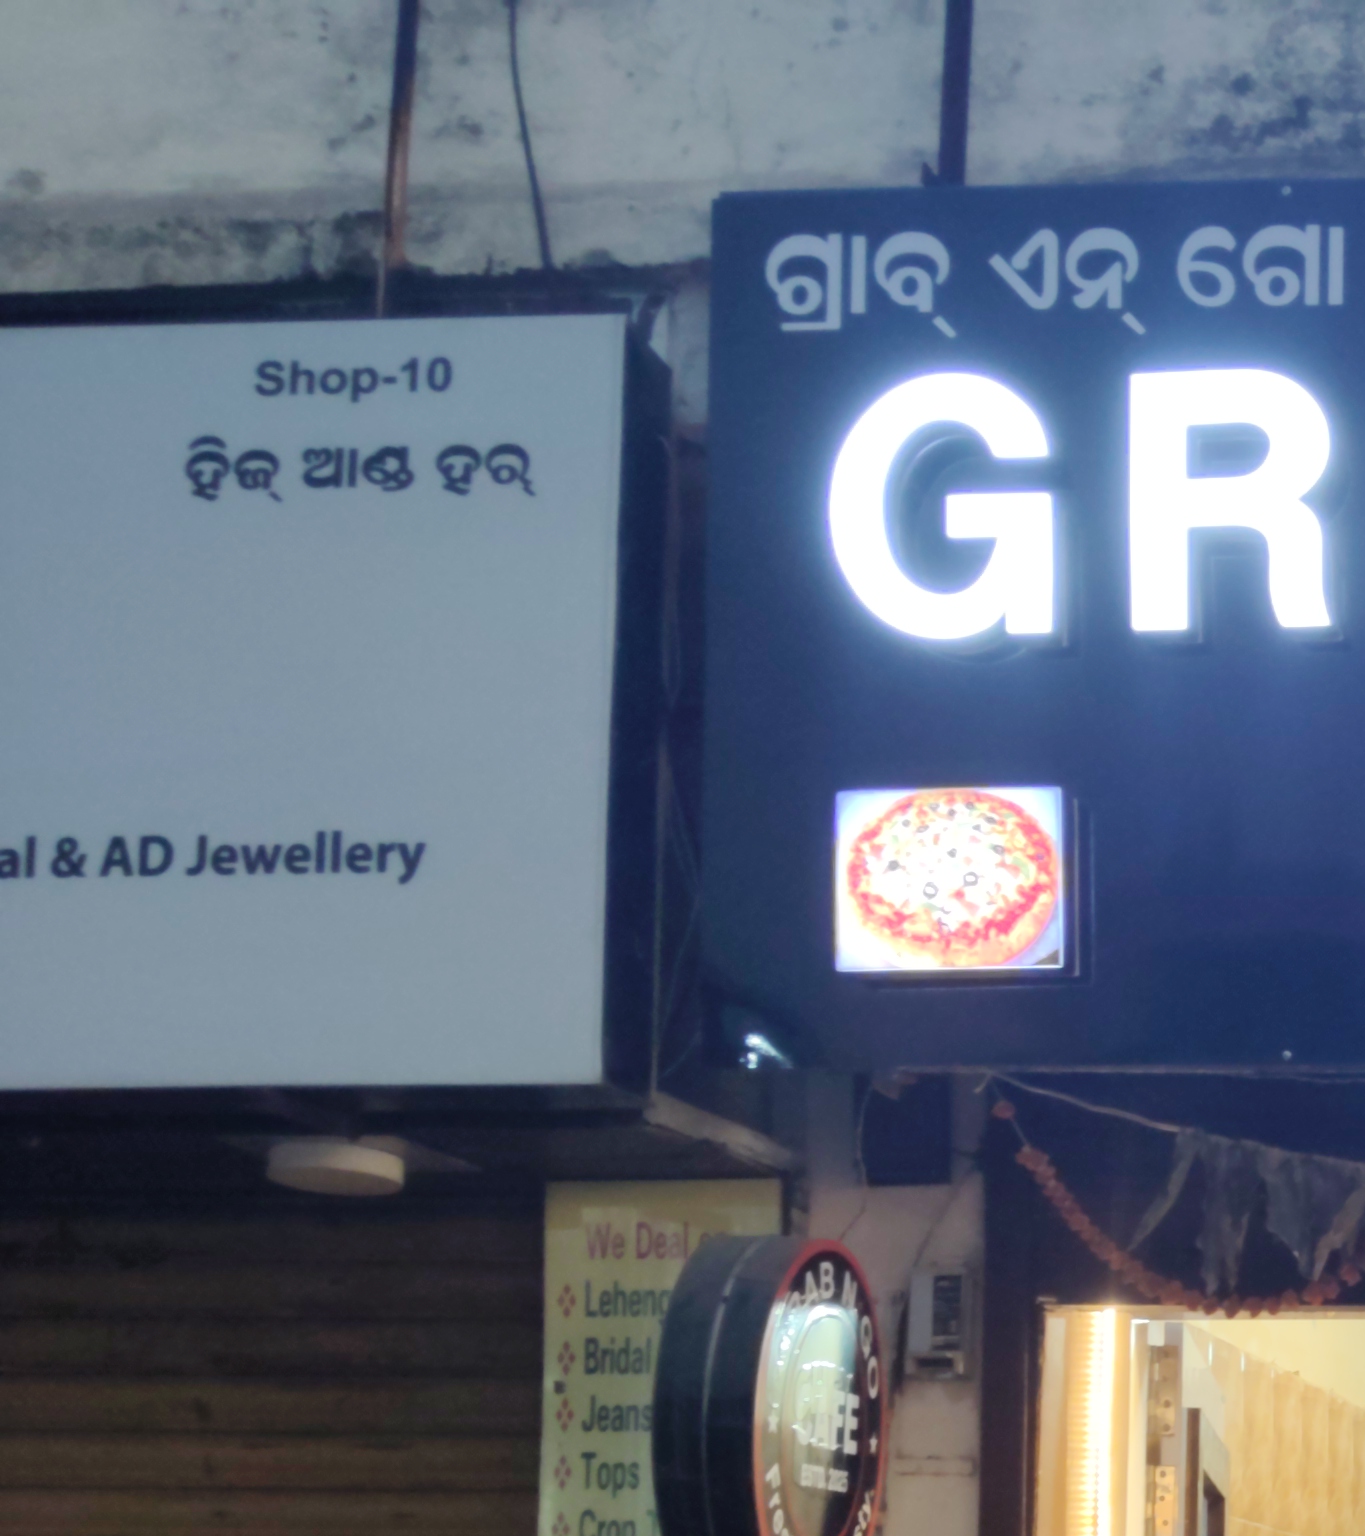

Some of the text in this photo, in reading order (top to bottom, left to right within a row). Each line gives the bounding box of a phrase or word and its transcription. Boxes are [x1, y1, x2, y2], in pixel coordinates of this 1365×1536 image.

[988, 226, 1146, 335] ଏନ୍
[1177, 224, 1344, 307] ଗୋ
[254, 356, 454, 403] Shop-10
[50, 836, 88, 879] &
[100, 835, 174, 878] AD
[185, 830, 427, 885] Jewellery
[586, 1221, 688, 1260] We Deal
[583, 1337, 651, 1376] Bridal
[581, 1395, 652, 1433] Jeans
[580, 1452, 640, 1498] Tops
